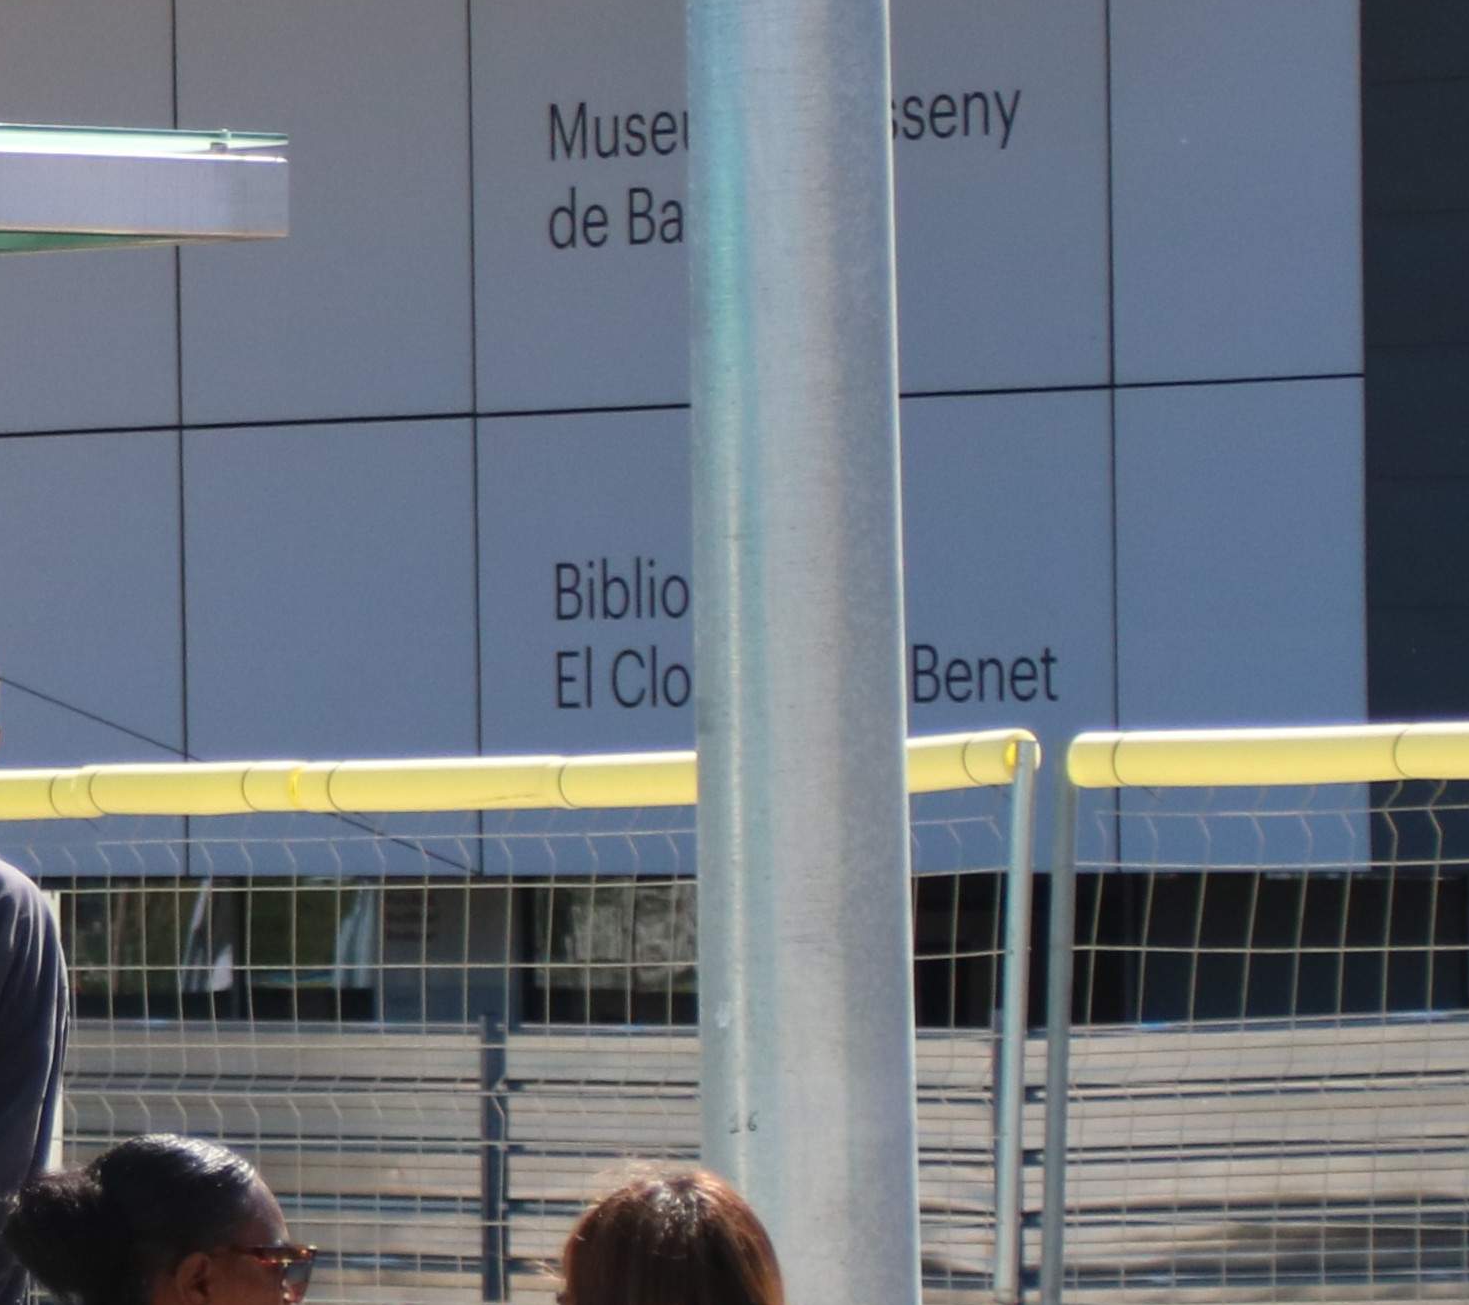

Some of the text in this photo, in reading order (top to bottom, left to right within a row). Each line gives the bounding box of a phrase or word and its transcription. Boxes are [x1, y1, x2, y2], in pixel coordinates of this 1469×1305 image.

[549, 187, 609, 249] de
[555, 556, 691, 620] Biblio
[556, 646, 592, 709] El
[912, 643, 1059, 704] Benet
